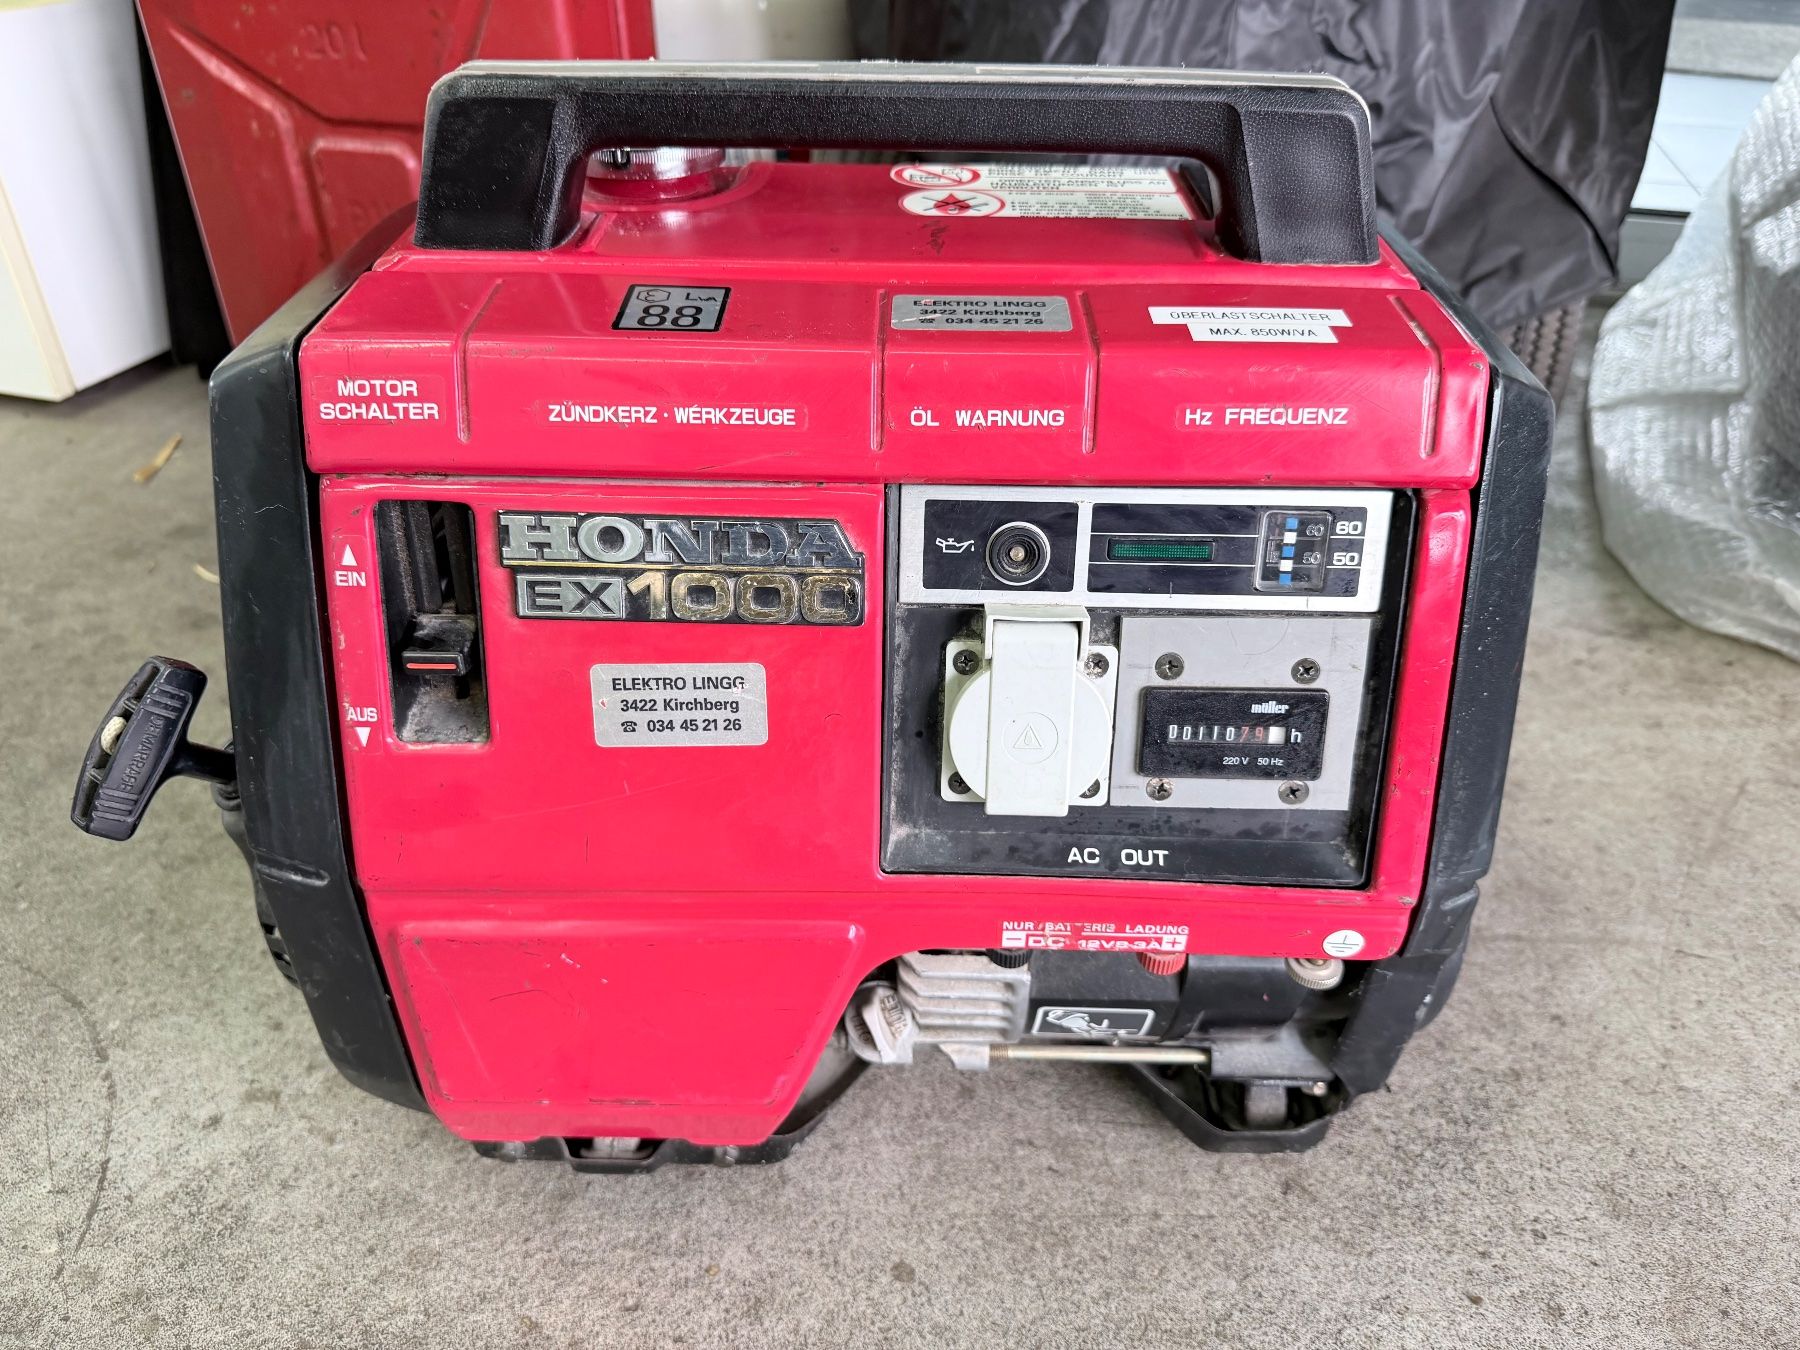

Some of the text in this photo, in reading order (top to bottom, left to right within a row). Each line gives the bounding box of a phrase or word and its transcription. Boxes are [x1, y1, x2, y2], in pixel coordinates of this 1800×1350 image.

[993, 301, 1047, 309] LINGG
[636, 304, 704, 328] 88
[919, 308, 1041, 318] 3422 Kirchberg
[945, 317, 1044, 326] 034 45 21 26
[1208, 328, 1248, 336] MAX.
[337, 379, 418, 397] MOTOR
[319, 402, 439, 420] SCHALTER
[548, 402, 796, 426] ZÜNDKERZ WERKZEUGE
[910, 406, 1065, 427] ÖL WARNUNG
[1184, 407, 1349, 426] Hz FREQUENZ
[1305, 523, 1325, 537] 60
[1335, 521, 1362, 535] 60
[500, 515, 862, 569] HONDA
[1302, 551, 1322, 565] 50
[1332, 552, 1360, 566] 50
[335, 570, 367, 587] EIN
[611, 676, 746, 691] ELEKTRO LINGG
[620, 698, 740, 714] 3422 Kirchberg
[1251, 700, 1290, 715] müller
[347, 706, 378, 722] AUS
[647, 718, 742, 732] 034 45 21 26
[1290, 728, 1302, 743] h
[1222, 756, 1285, 766] 220 V 50 Hz
[1067, 846, 1169, 867] AC OUT
[1003, 921, 1035, 931] NUR
[1125, 924, 1190, 935] LADUNG
[1027, 936, 1066, 948] DC
